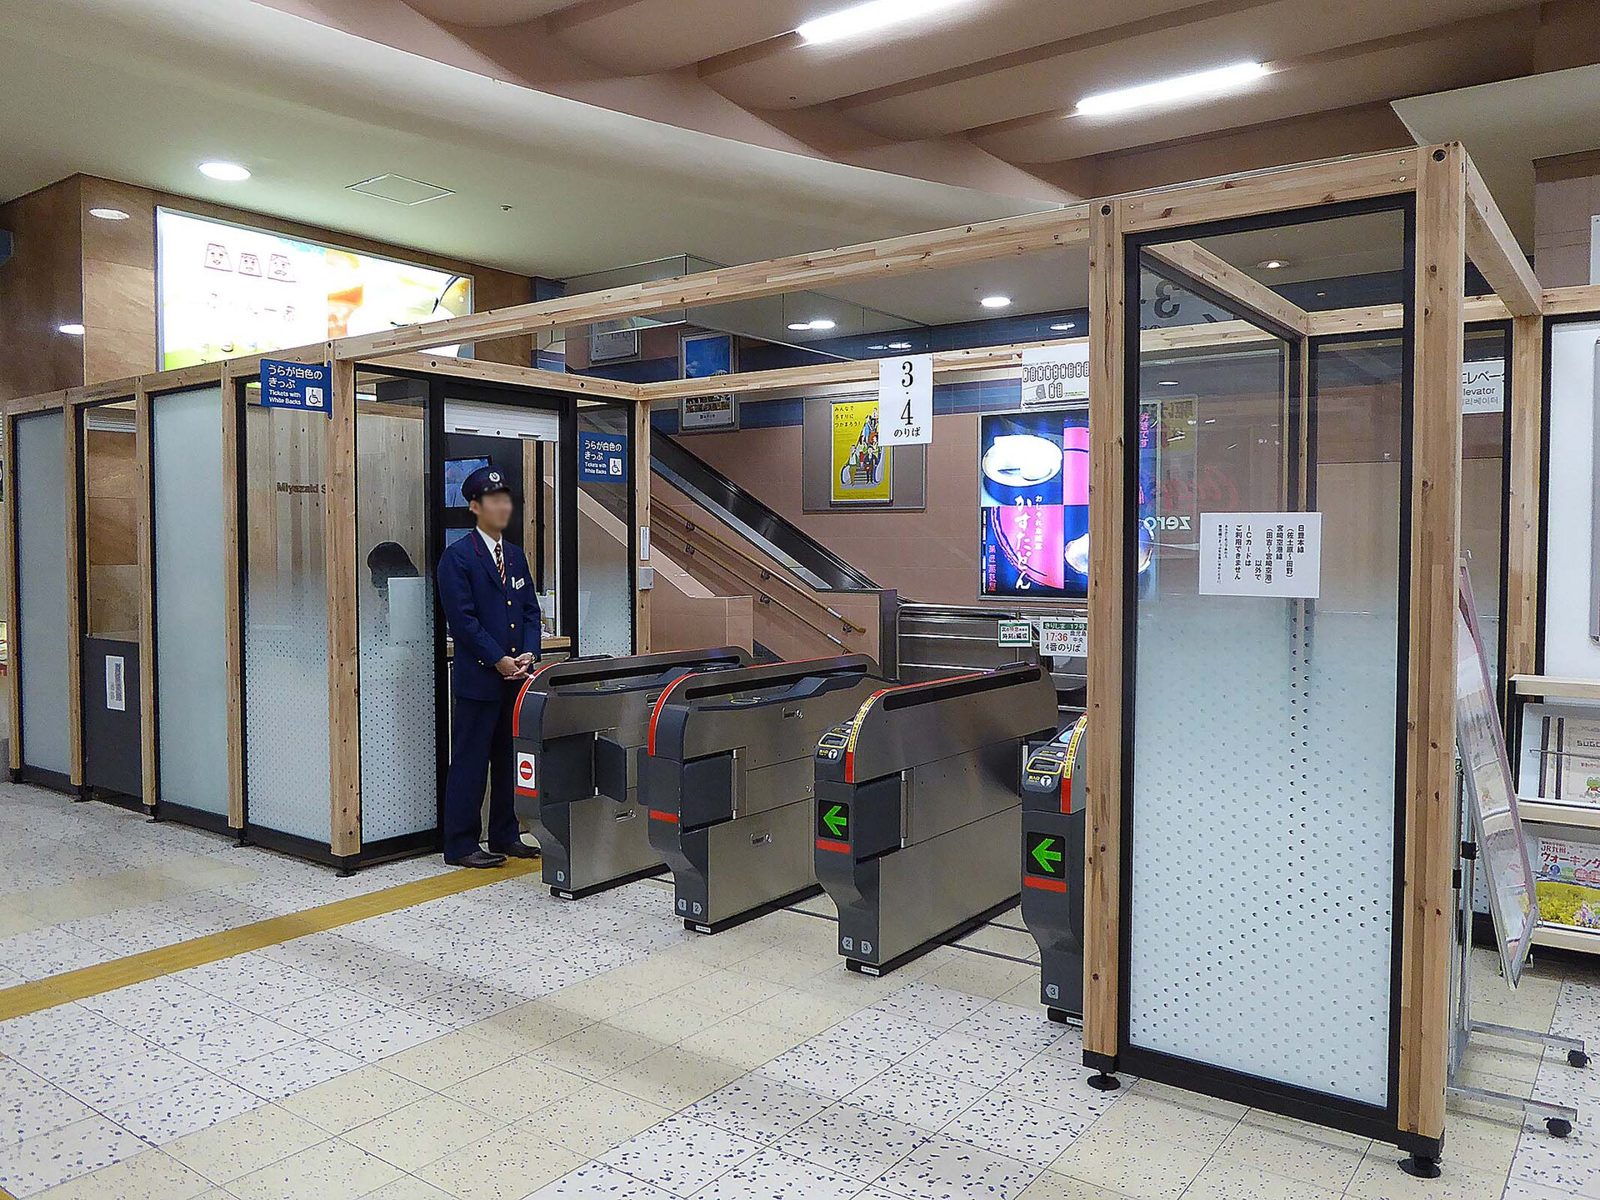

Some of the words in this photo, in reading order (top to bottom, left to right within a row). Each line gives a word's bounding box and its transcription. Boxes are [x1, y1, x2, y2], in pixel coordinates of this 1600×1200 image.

[268, 364, 324, 380] うらが白色の
[268, 377, 296, 389] きっぷ
[269, 389, 289, 397] Tickets
[269, 396, 285, 404] White
[286, 397, 302, 405] Backs
[894, 427, 921, 438] のりば
[584, 440, 623, 452] うらが白色の
[584, 451, 604, 461] きっぷ
[277, 482, 319, 495] Miyazaki
[1234, 524, 1243, 580] ご利用できません
[1254, 560, 1263, 581] 以外で
[1045, 632, 1068, 642] 17:36
[1045, 643, 1082, 653] 4番のりば
